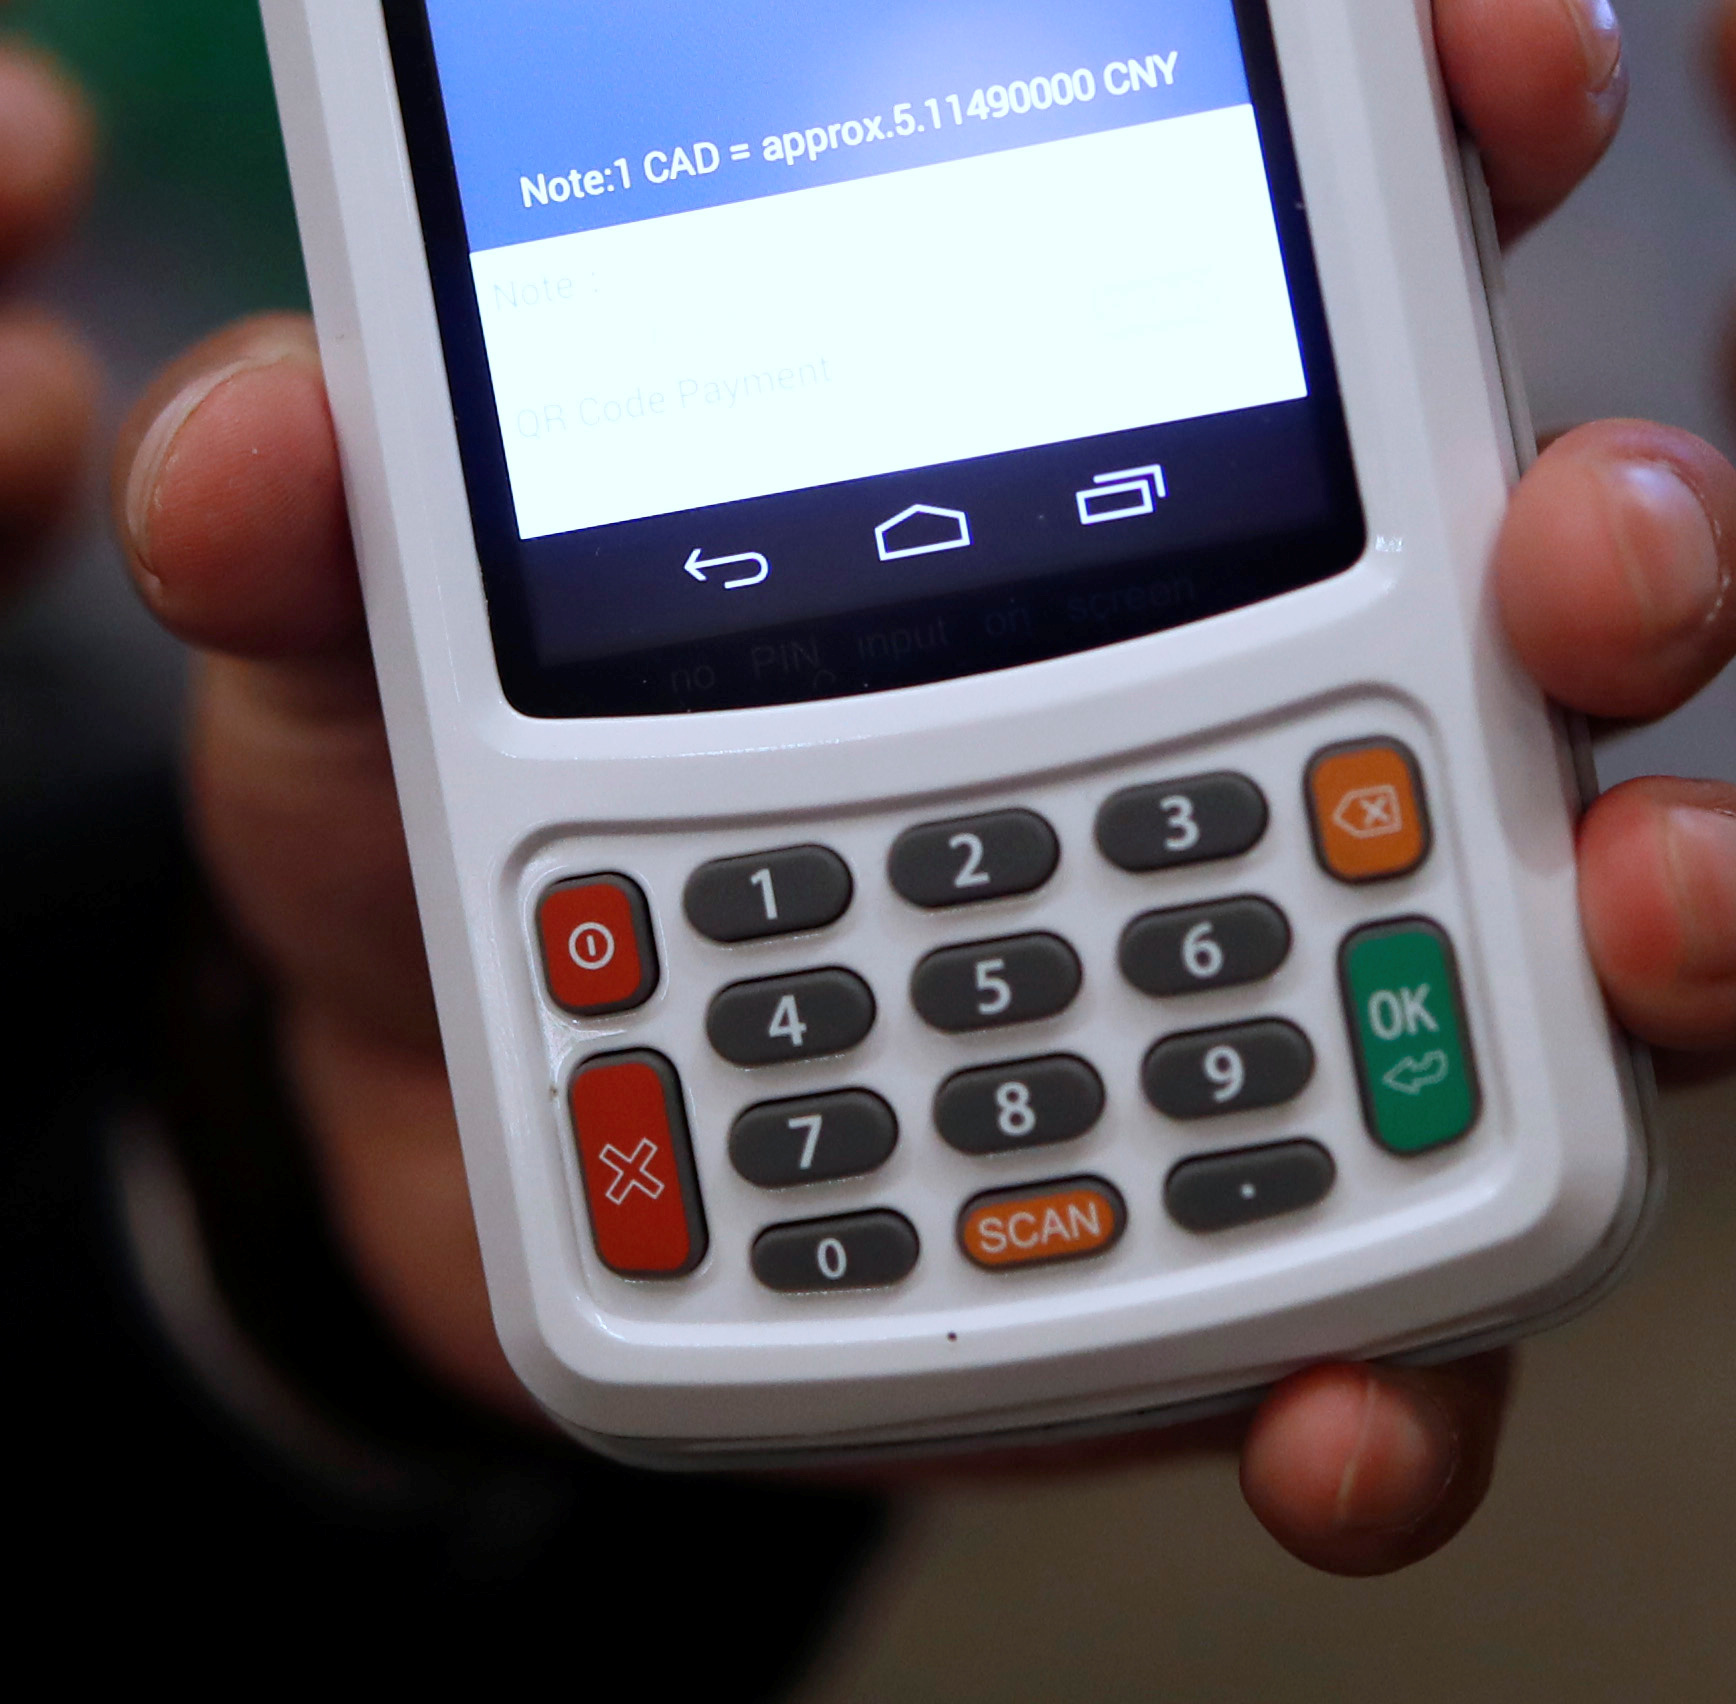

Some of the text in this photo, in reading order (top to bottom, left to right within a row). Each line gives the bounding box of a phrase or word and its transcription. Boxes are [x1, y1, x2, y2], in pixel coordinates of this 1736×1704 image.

[645, 143, 719, 182] CAD
[762, 68, 1096, 164] approx.5.11490000
[1105, 52, 1179, 96] CNY
[676, 355, 832, 409] Payment
[1163, 797, 1197, 849] 3
[950, 833, 988, 886] 2
[751, 869, 777, 919] 1
[1184, 925, 1221, 975] 6
[977, 960, 1010, 1012] 5
[769, 996, 805, 1045] 4
[1369, 984, 1437, 1041] OK
[1206, 1048, 1242, 1098] 9
[997, 1083, 1034, 1134] 8
[789, 1116, 821, 1167] 7
[977, 1203, 1102, 1256] SCAN
[817, 1238, 847, 1280] 0
